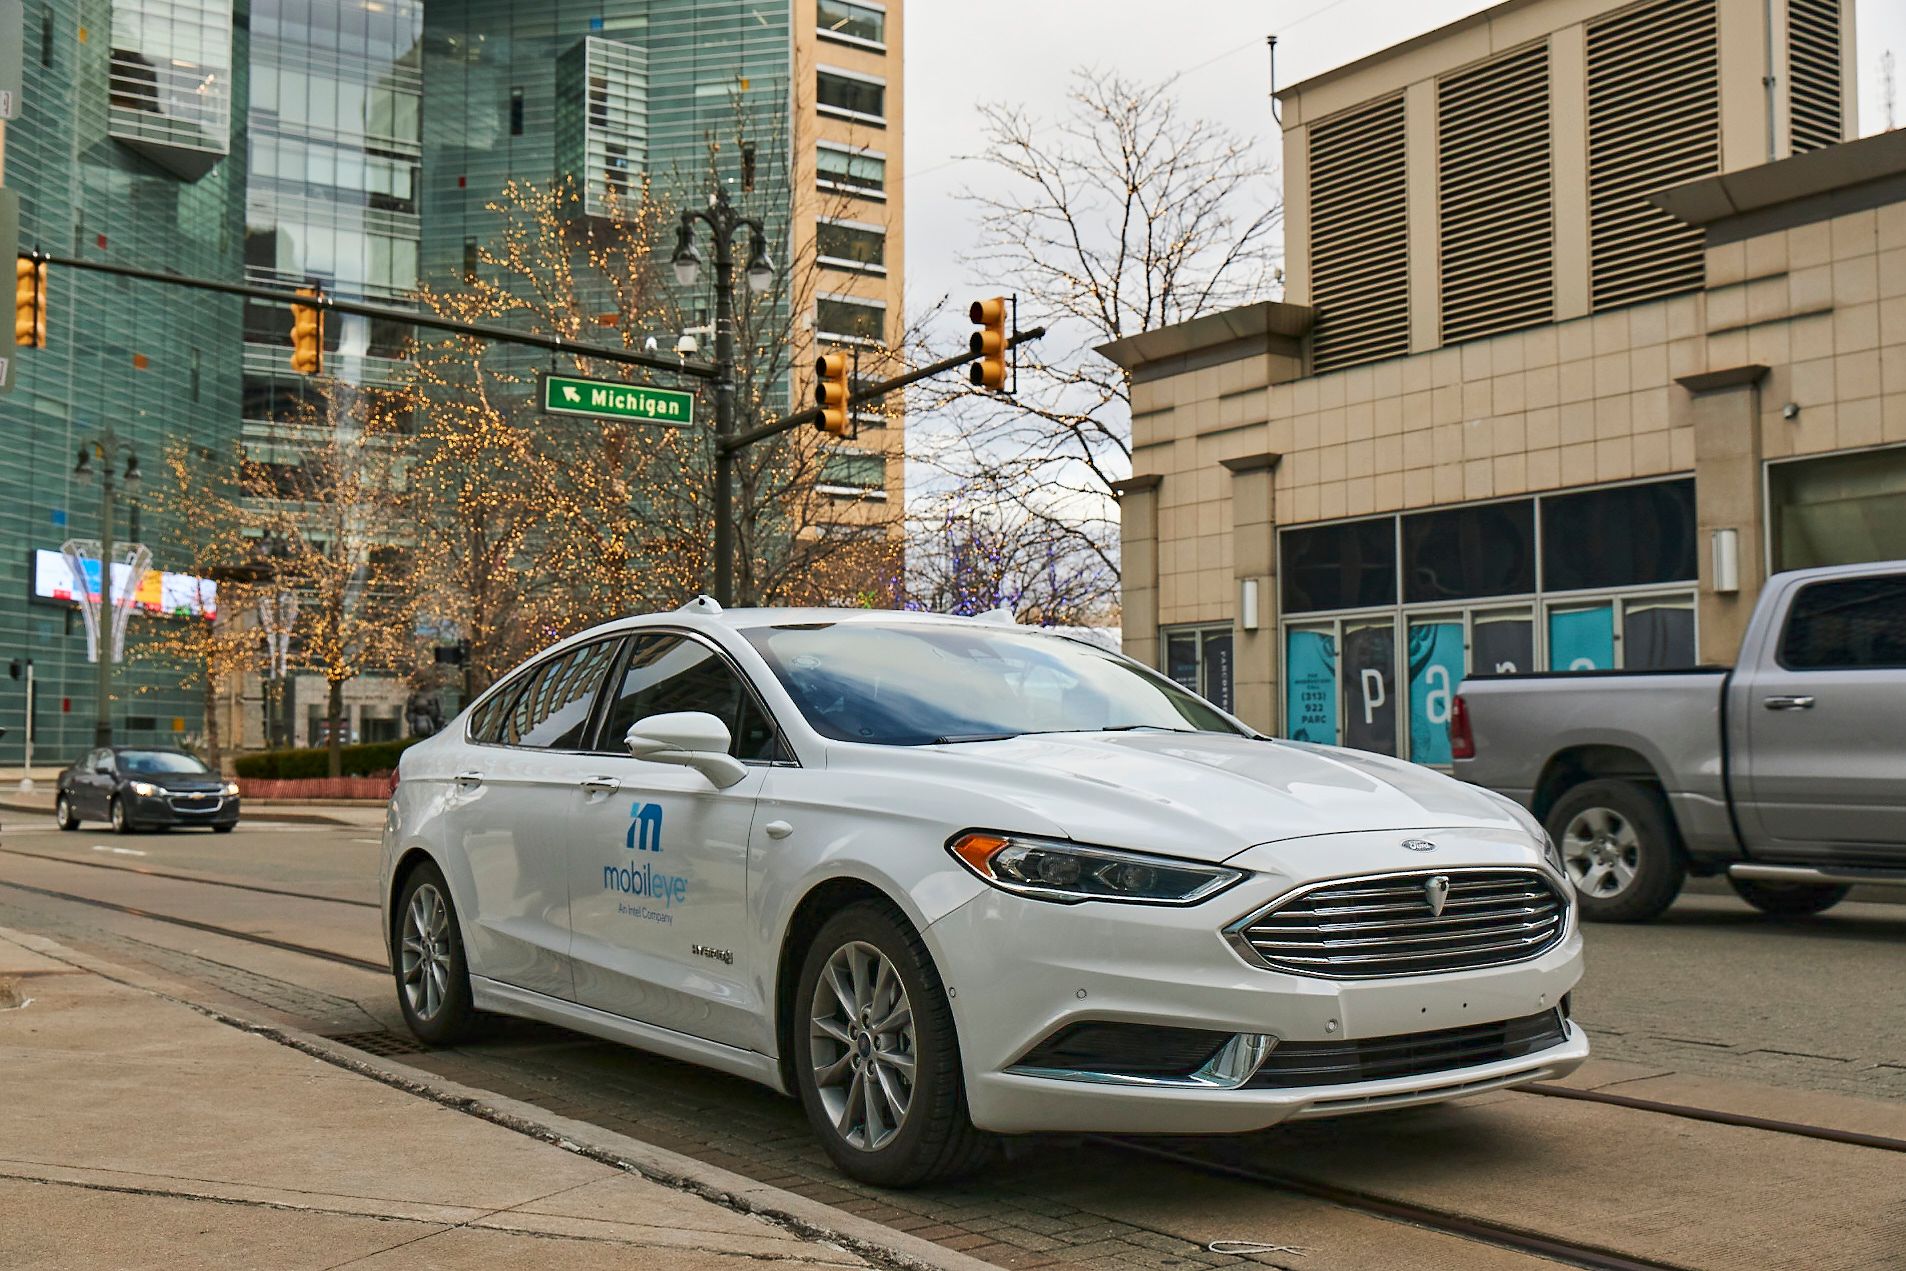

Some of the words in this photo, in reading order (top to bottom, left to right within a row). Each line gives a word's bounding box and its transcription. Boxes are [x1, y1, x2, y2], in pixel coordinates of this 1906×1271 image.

[591, 388, 679, 416] Michigan
[1302, 715, 1327, 724] PARC
[603, 860, 687, 909] mobileye
[618, 902, 628, 914] An
[628, 904, 641, 917] Intel
[642, 906, 673, 926] Company
